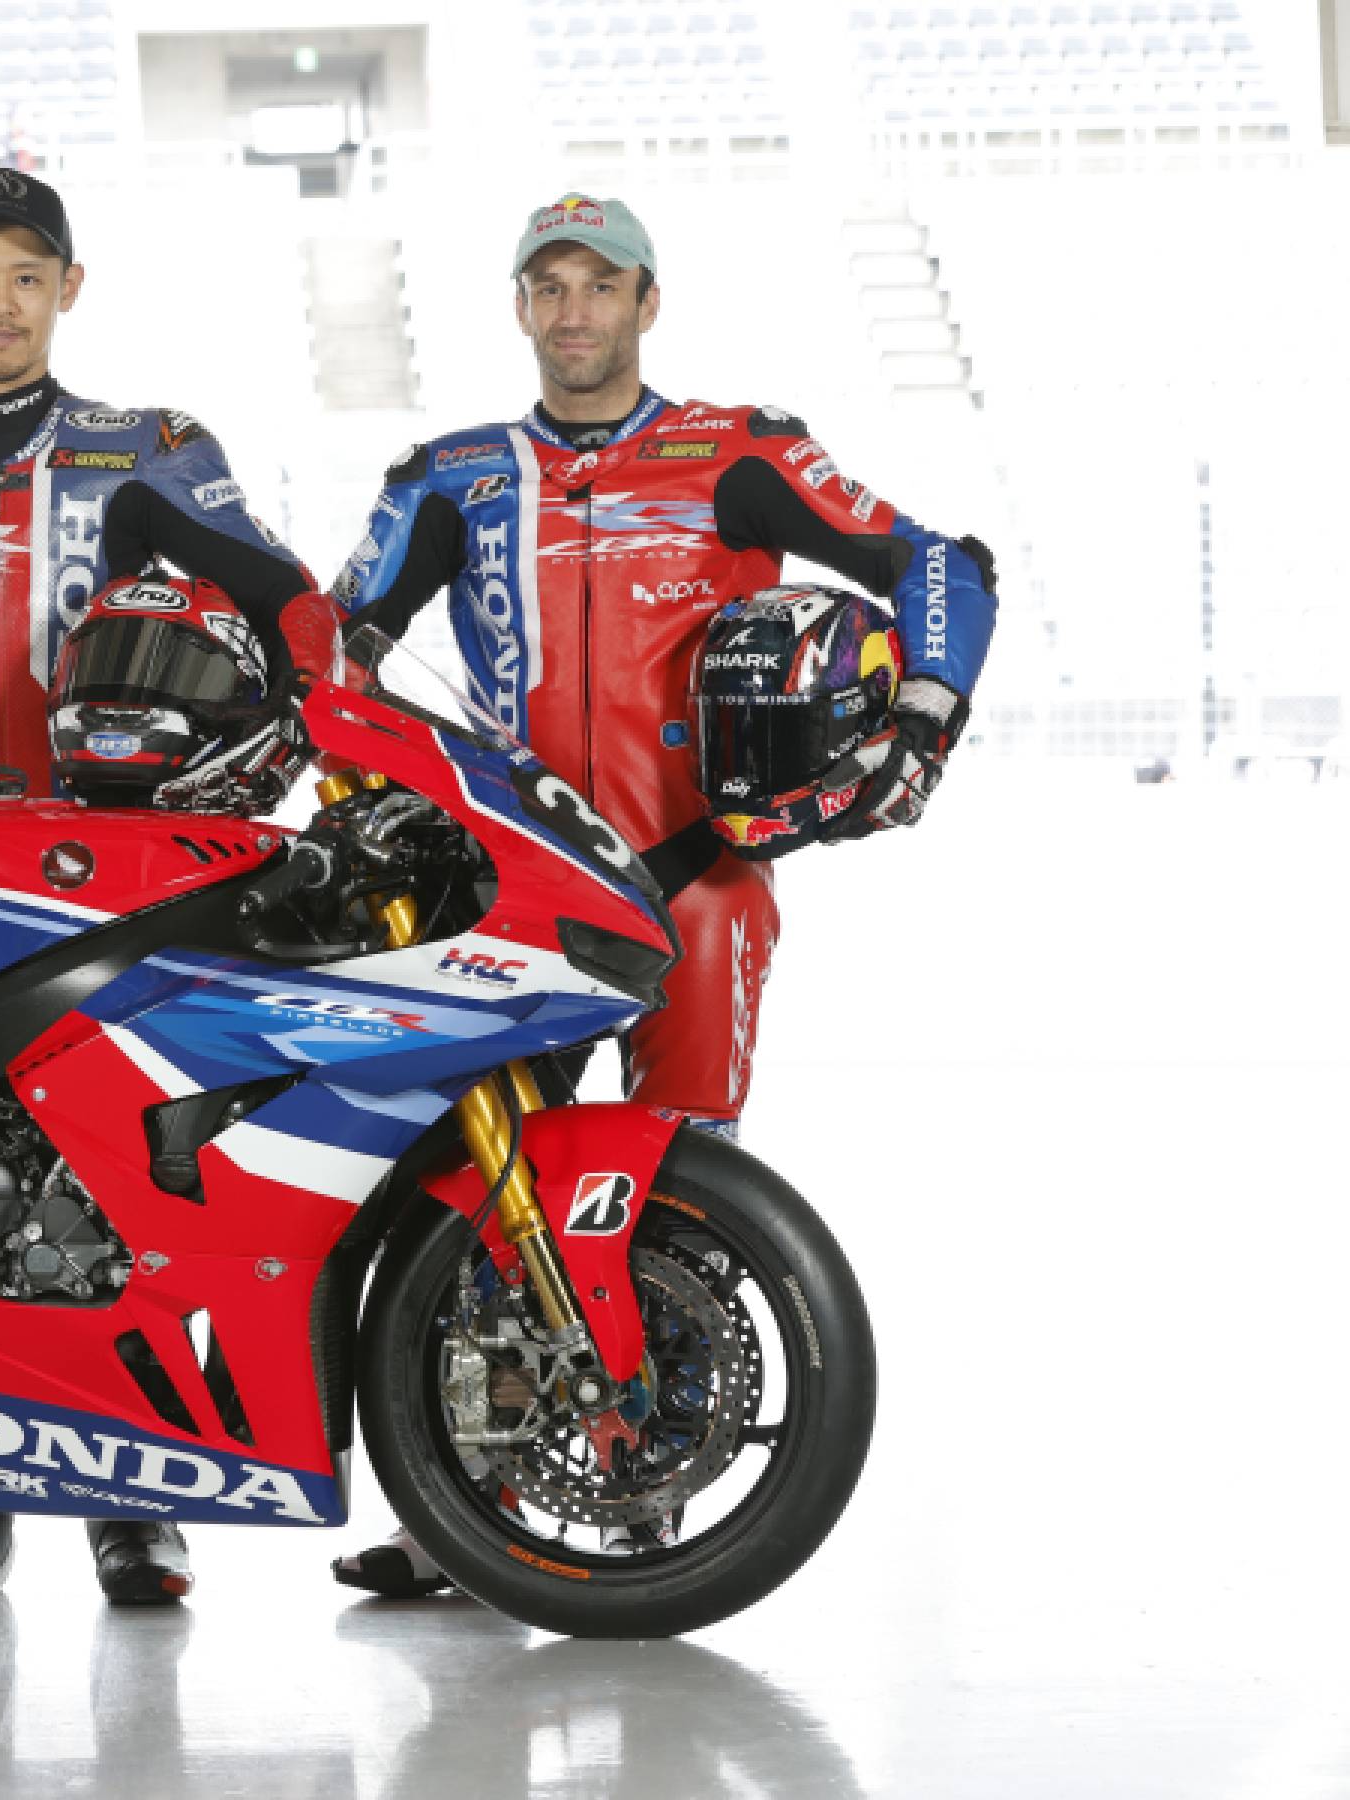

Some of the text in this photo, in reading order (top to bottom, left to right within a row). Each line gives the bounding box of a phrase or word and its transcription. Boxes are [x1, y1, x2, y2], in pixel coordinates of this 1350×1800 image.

[534, 212, 605, 235] Red Bull
[107, 583, 188, 610] Arai
[924, 542, 947, 660] HONDA
[476, 521, 521, 738] HOND
[704, 653, 781, 670] SHARK
[753, 693, 812, 706] WINGS
[816, 782, 861, 822] Re
[536, 775, 631, 869] 3
[438, 948, 528, 983] HRC
[253, 993, 434, 1033] CBR
[270, 1007, 405, 1037] FIREBLADE
